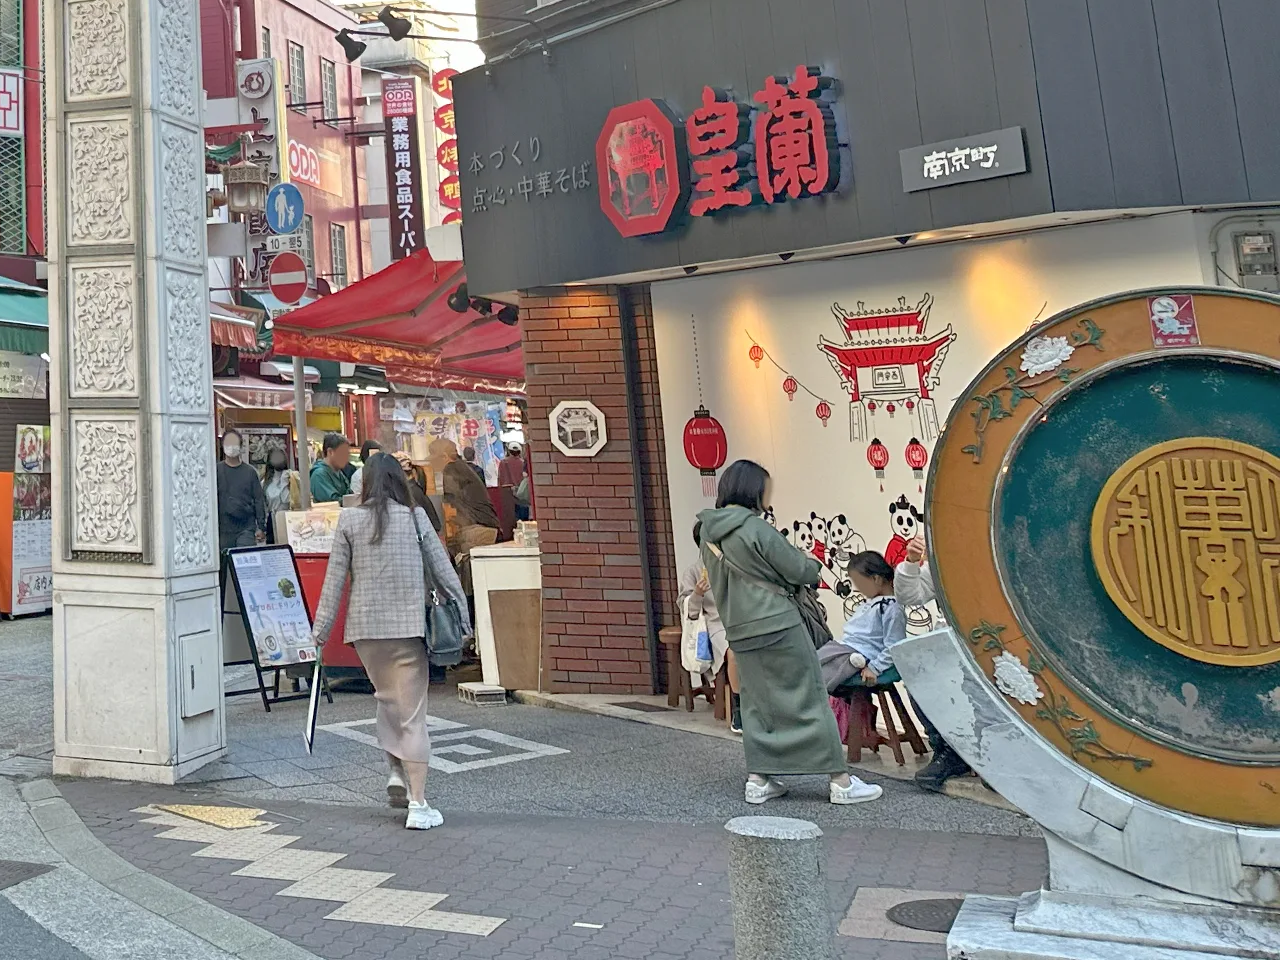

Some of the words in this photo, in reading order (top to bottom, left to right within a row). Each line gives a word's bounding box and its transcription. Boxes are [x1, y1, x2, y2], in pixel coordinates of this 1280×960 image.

[288, 139, 320, 185] ODA
[468, 136, 541, 177] 本づくり
[684, 64, 829, 217] 皇蘭
[923, 144, 998, 180] 南京町
[391, 116, 416, 257] 業務用食品スーパー
